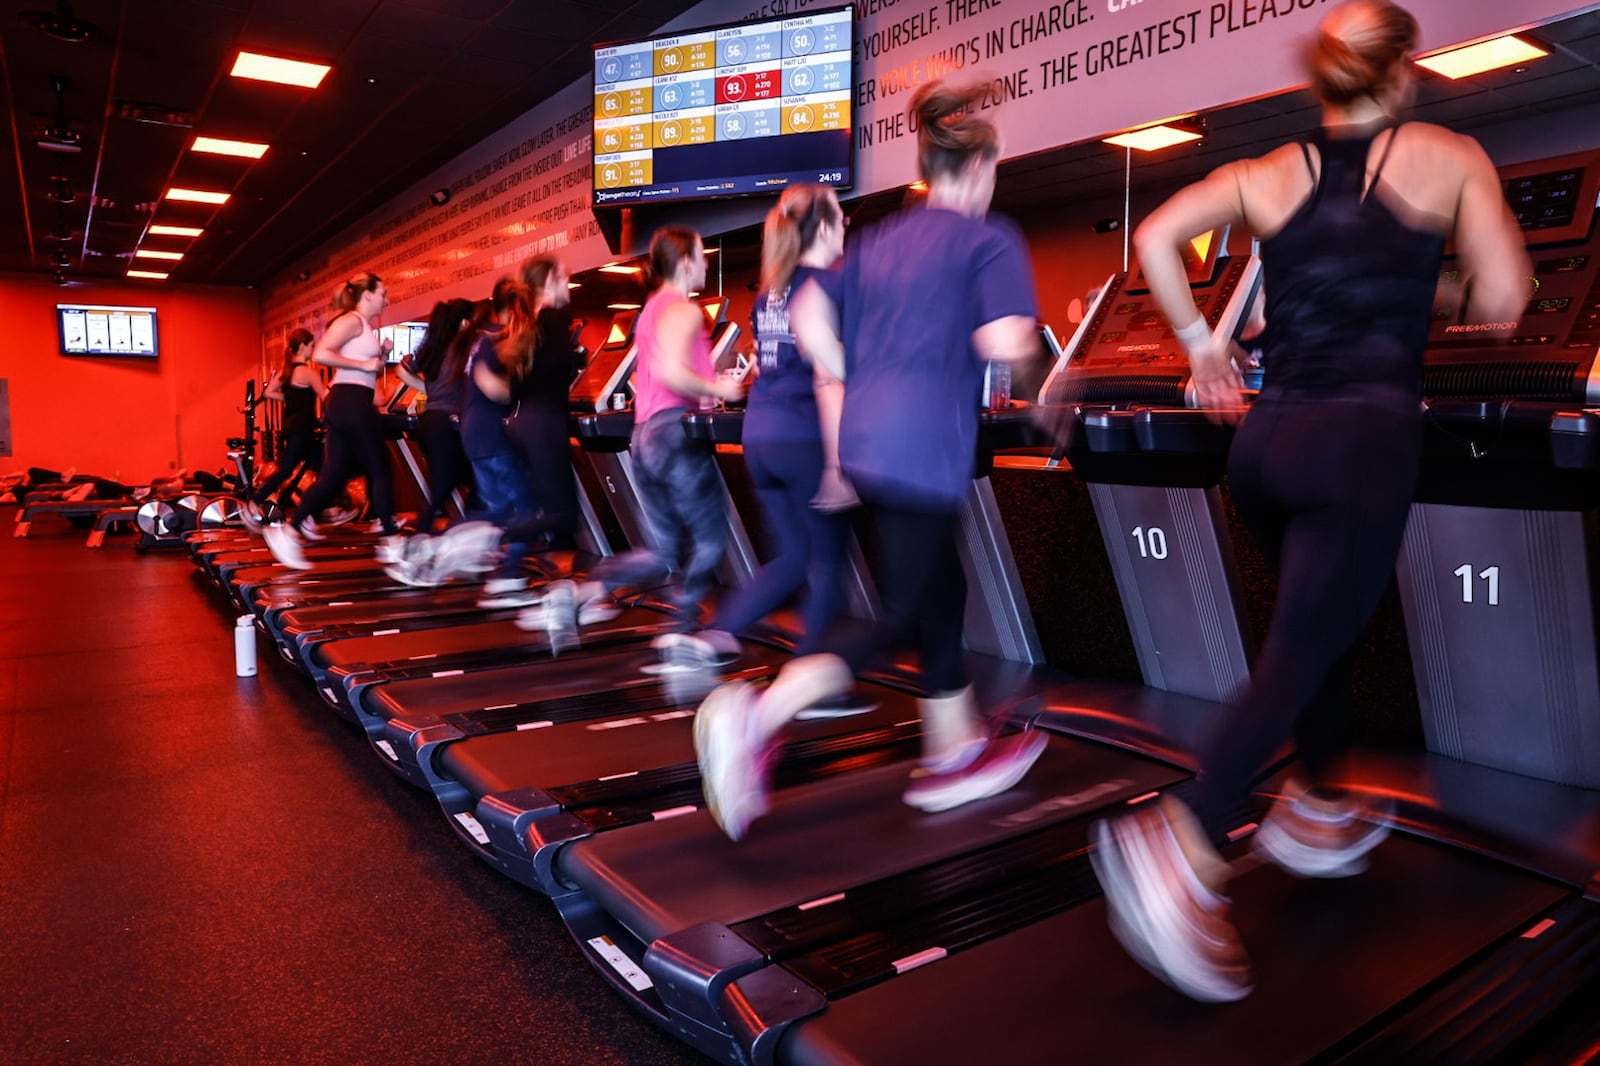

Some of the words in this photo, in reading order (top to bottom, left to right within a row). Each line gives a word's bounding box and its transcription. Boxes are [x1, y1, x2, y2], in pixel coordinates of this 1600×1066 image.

[863, 6, 941, 61] YOURSELF.
[945, 0, 1002, 25] THER
[880, 59, 921, 98] VOICE
[925, 36, 980, 80] WHO'S
[986, 27, 1004, 59] IN
[1010, 0, 1094, 50] CHARGE.
[859, 123, 873, 149] IN
[876, 112, 904, 143] THE
[981, 68, 1034, 110] ZONE.
[1040, 51, 1078, 91] THE
[1086, 10, 1202, 76] GREATEST
[563, 141, 578, 163] LIVE
[578, 133, 592, 156] LIFE
[551, 175, 562, 197] THE
[819, 172, 842, 183] 24:19
[553, 202, 569, 222] PUSH
[538, 237, 547, 254] UP
[546, 234, 555, 252] TO
[1445, 321, 1518, 334] FREEMOTION
[1131, 526, 1169, 561] 10
[1453, 563, 1500, 606] 11
